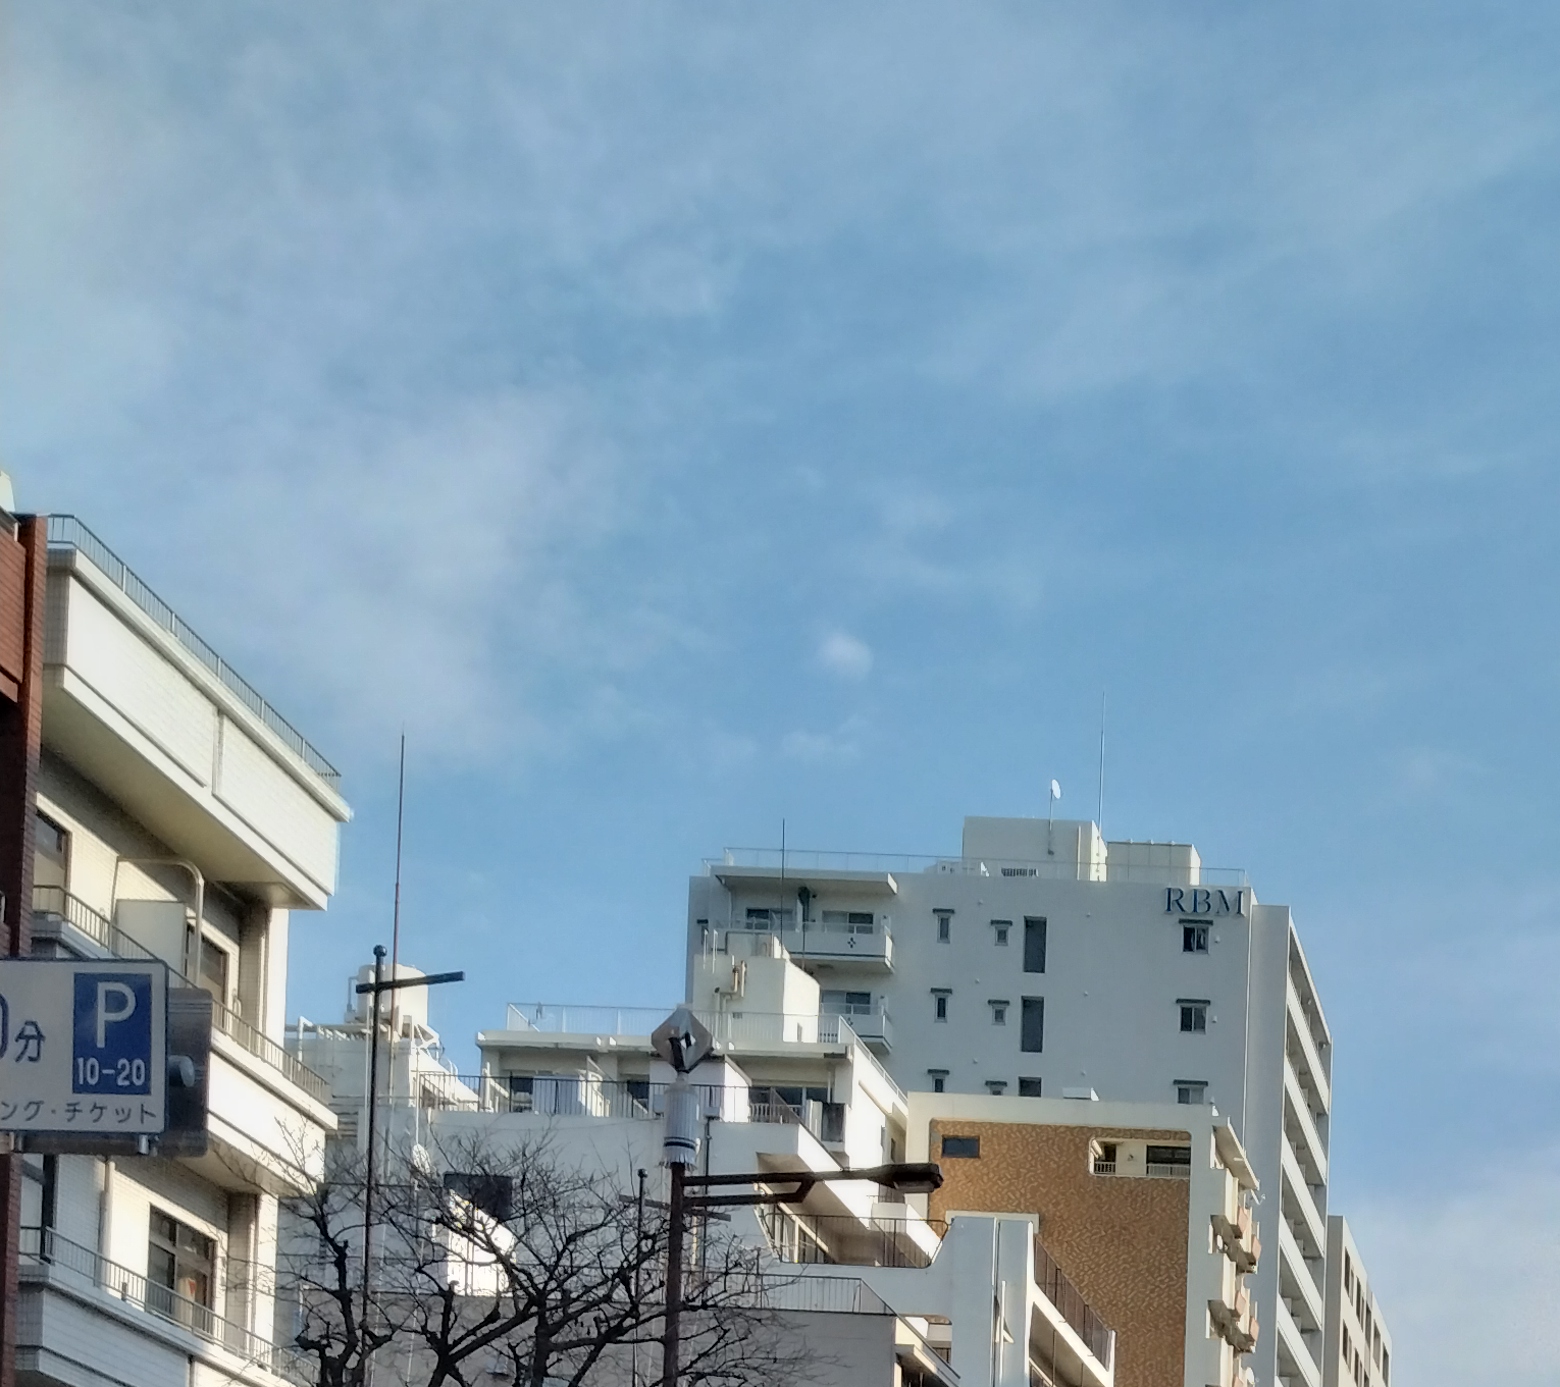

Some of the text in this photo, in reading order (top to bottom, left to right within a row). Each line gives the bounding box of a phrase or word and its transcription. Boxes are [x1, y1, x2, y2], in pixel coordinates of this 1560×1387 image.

[1164, 887, 1246, 915] RBM
[97, 981, 137, 1049] P
[77, 1057, 146, 1087] 10-20
